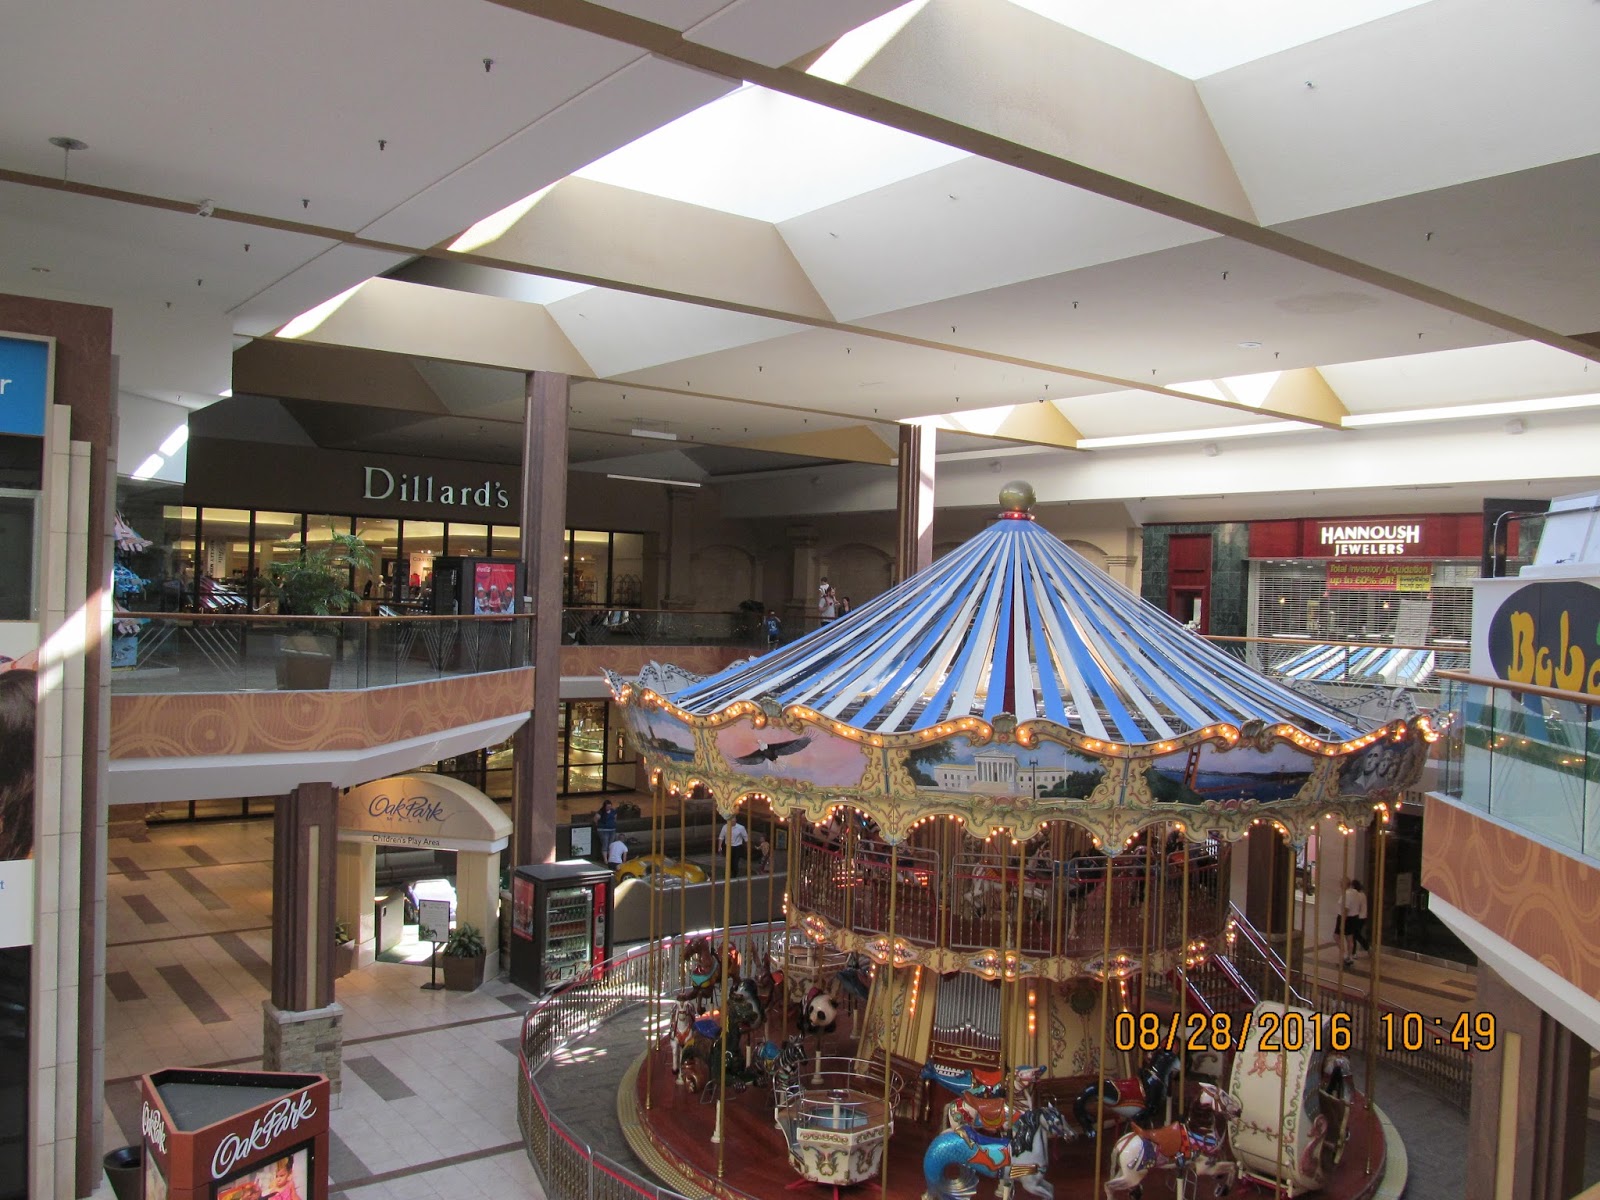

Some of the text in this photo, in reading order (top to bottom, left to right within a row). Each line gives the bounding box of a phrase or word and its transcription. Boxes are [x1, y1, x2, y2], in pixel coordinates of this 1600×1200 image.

[363, 466, 509, 508] Dillard's
[1320, 525, 1420, 544] HANNOUSH
[1334, 544, 1404, 556] JEWELERS
[1330, 564, 1347, 573] Total
[1385, 564, 1428, 574] Liquidation
[372, 834, 440, 847] Children's Play Area
